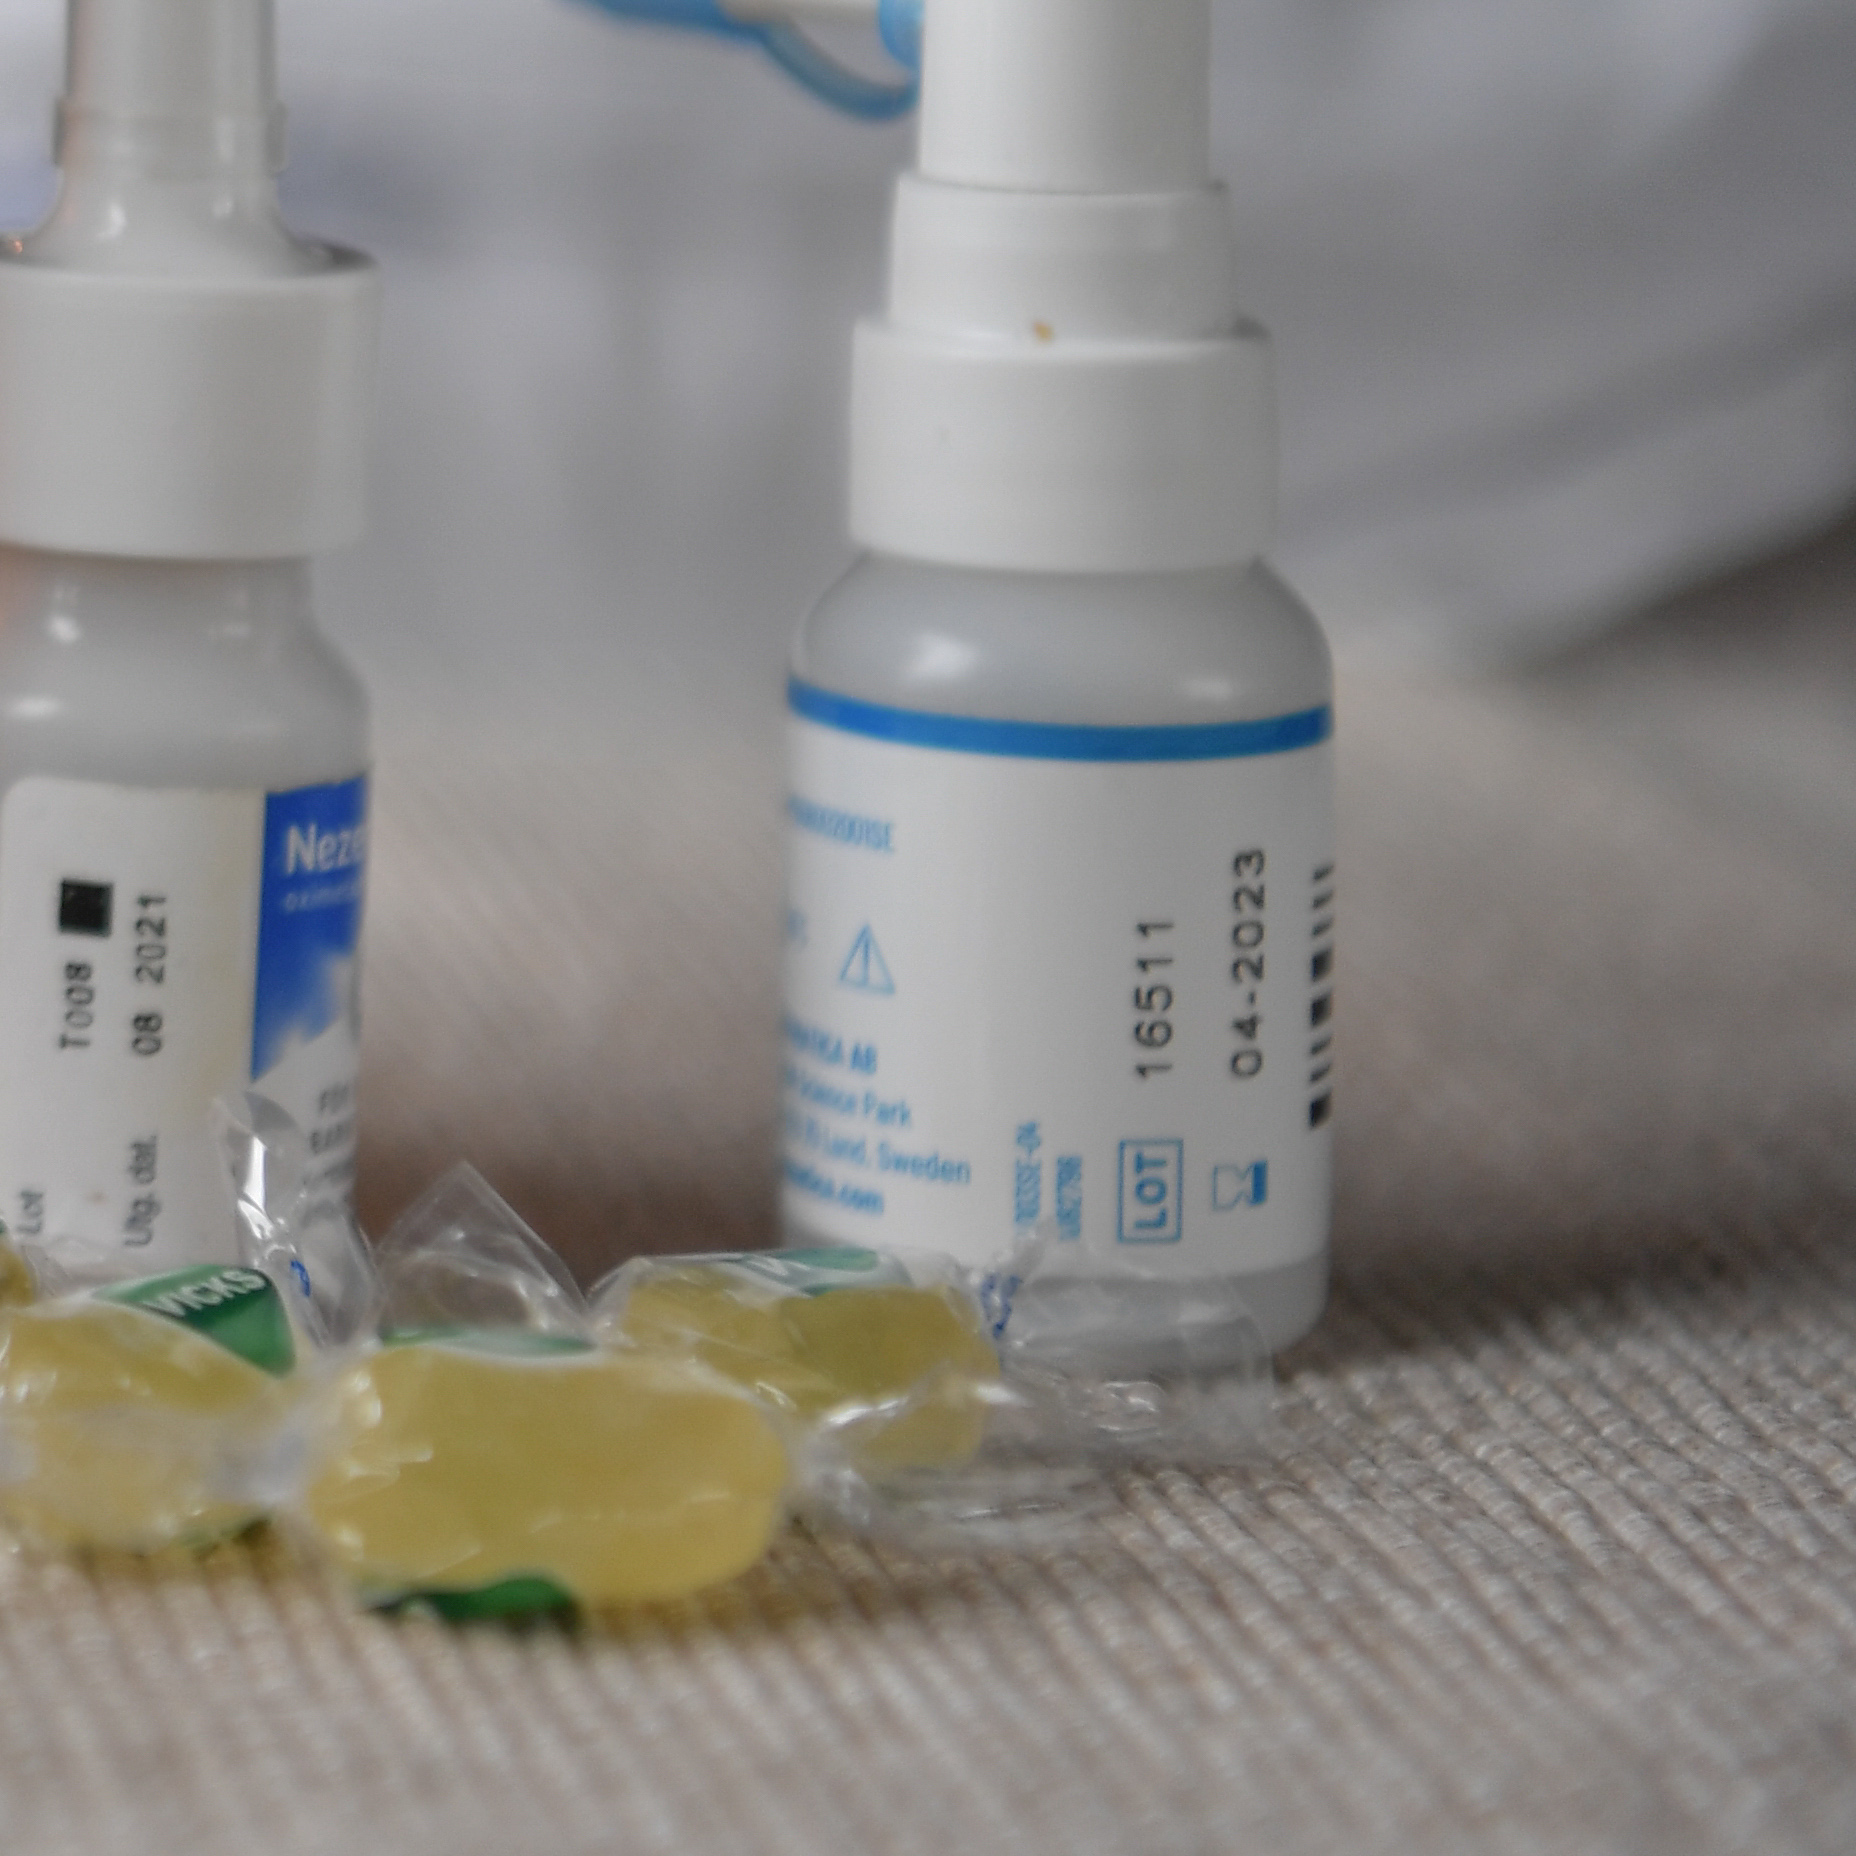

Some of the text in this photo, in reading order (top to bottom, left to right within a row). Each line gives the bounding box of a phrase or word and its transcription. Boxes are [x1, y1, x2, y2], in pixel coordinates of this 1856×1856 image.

[135, 894, 167, 985] 2021
[1230, 848, 1267, 1081] 04-2023
[60, 961, 94, 1051] T008
[131, 1013, 165, 1056] 08
[1134, 917, 1175, 1080] 16511
[1134, 1150, 1169, 1231] LOT
[141, 1270, 266, 1316] VICKS
